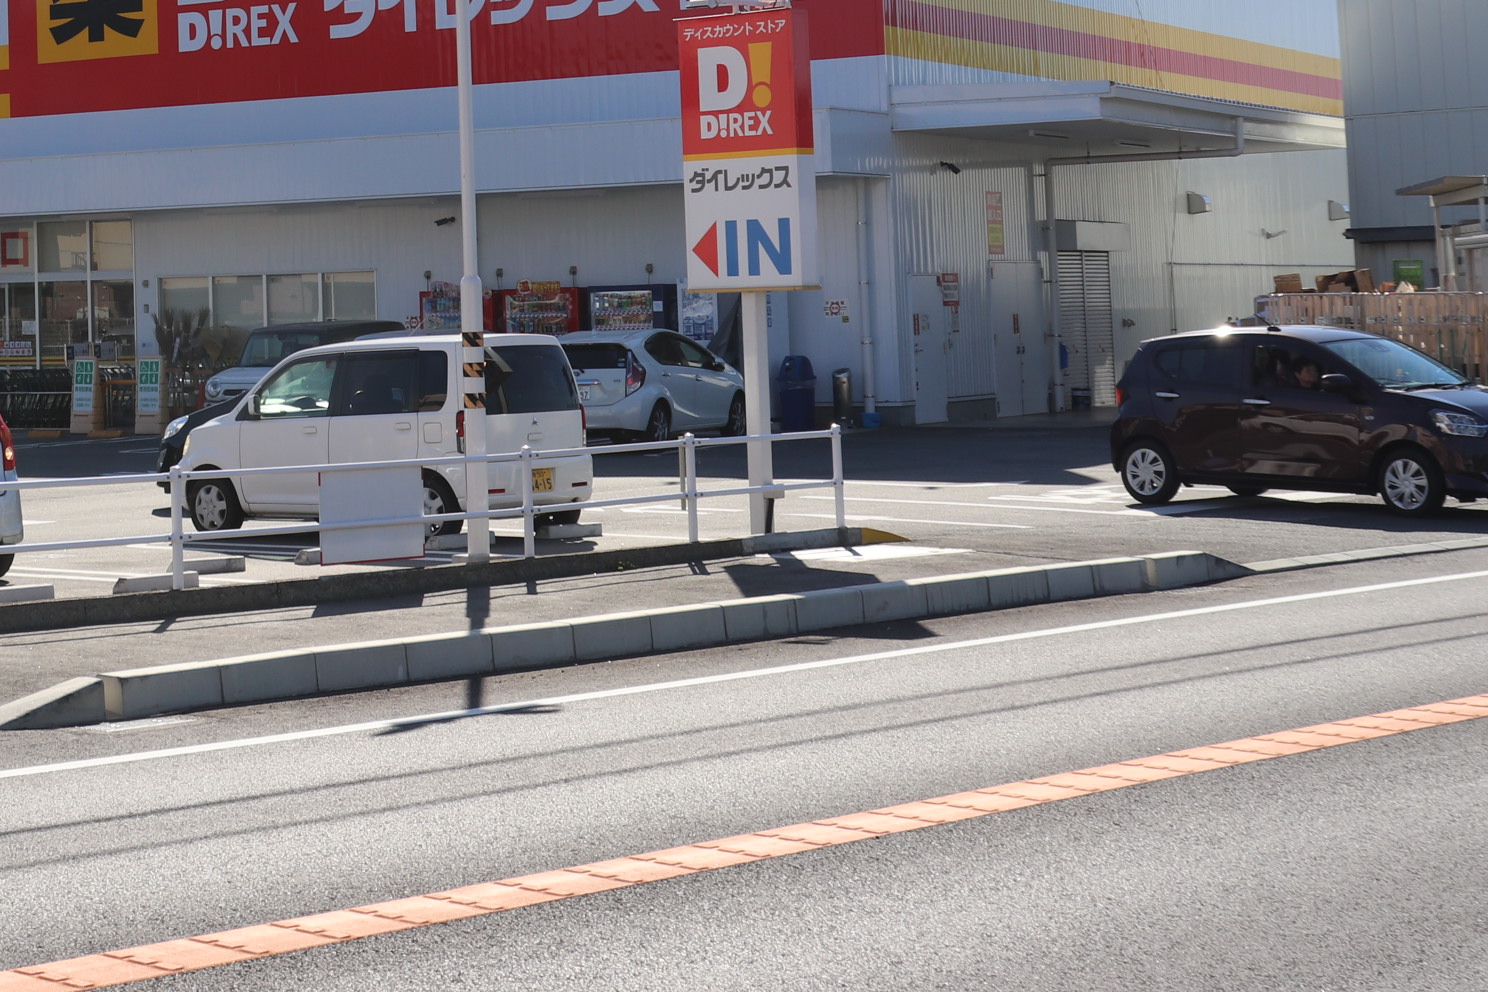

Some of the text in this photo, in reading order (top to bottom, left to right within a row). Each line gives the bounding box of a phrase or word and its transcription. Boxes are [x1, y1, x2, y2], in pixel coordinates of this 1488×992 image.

[683, 19, 786, 41] ディスカウント ストア
[688, 165, 792, 193] ダイレックス
[724, 217, 792, 277] IN
